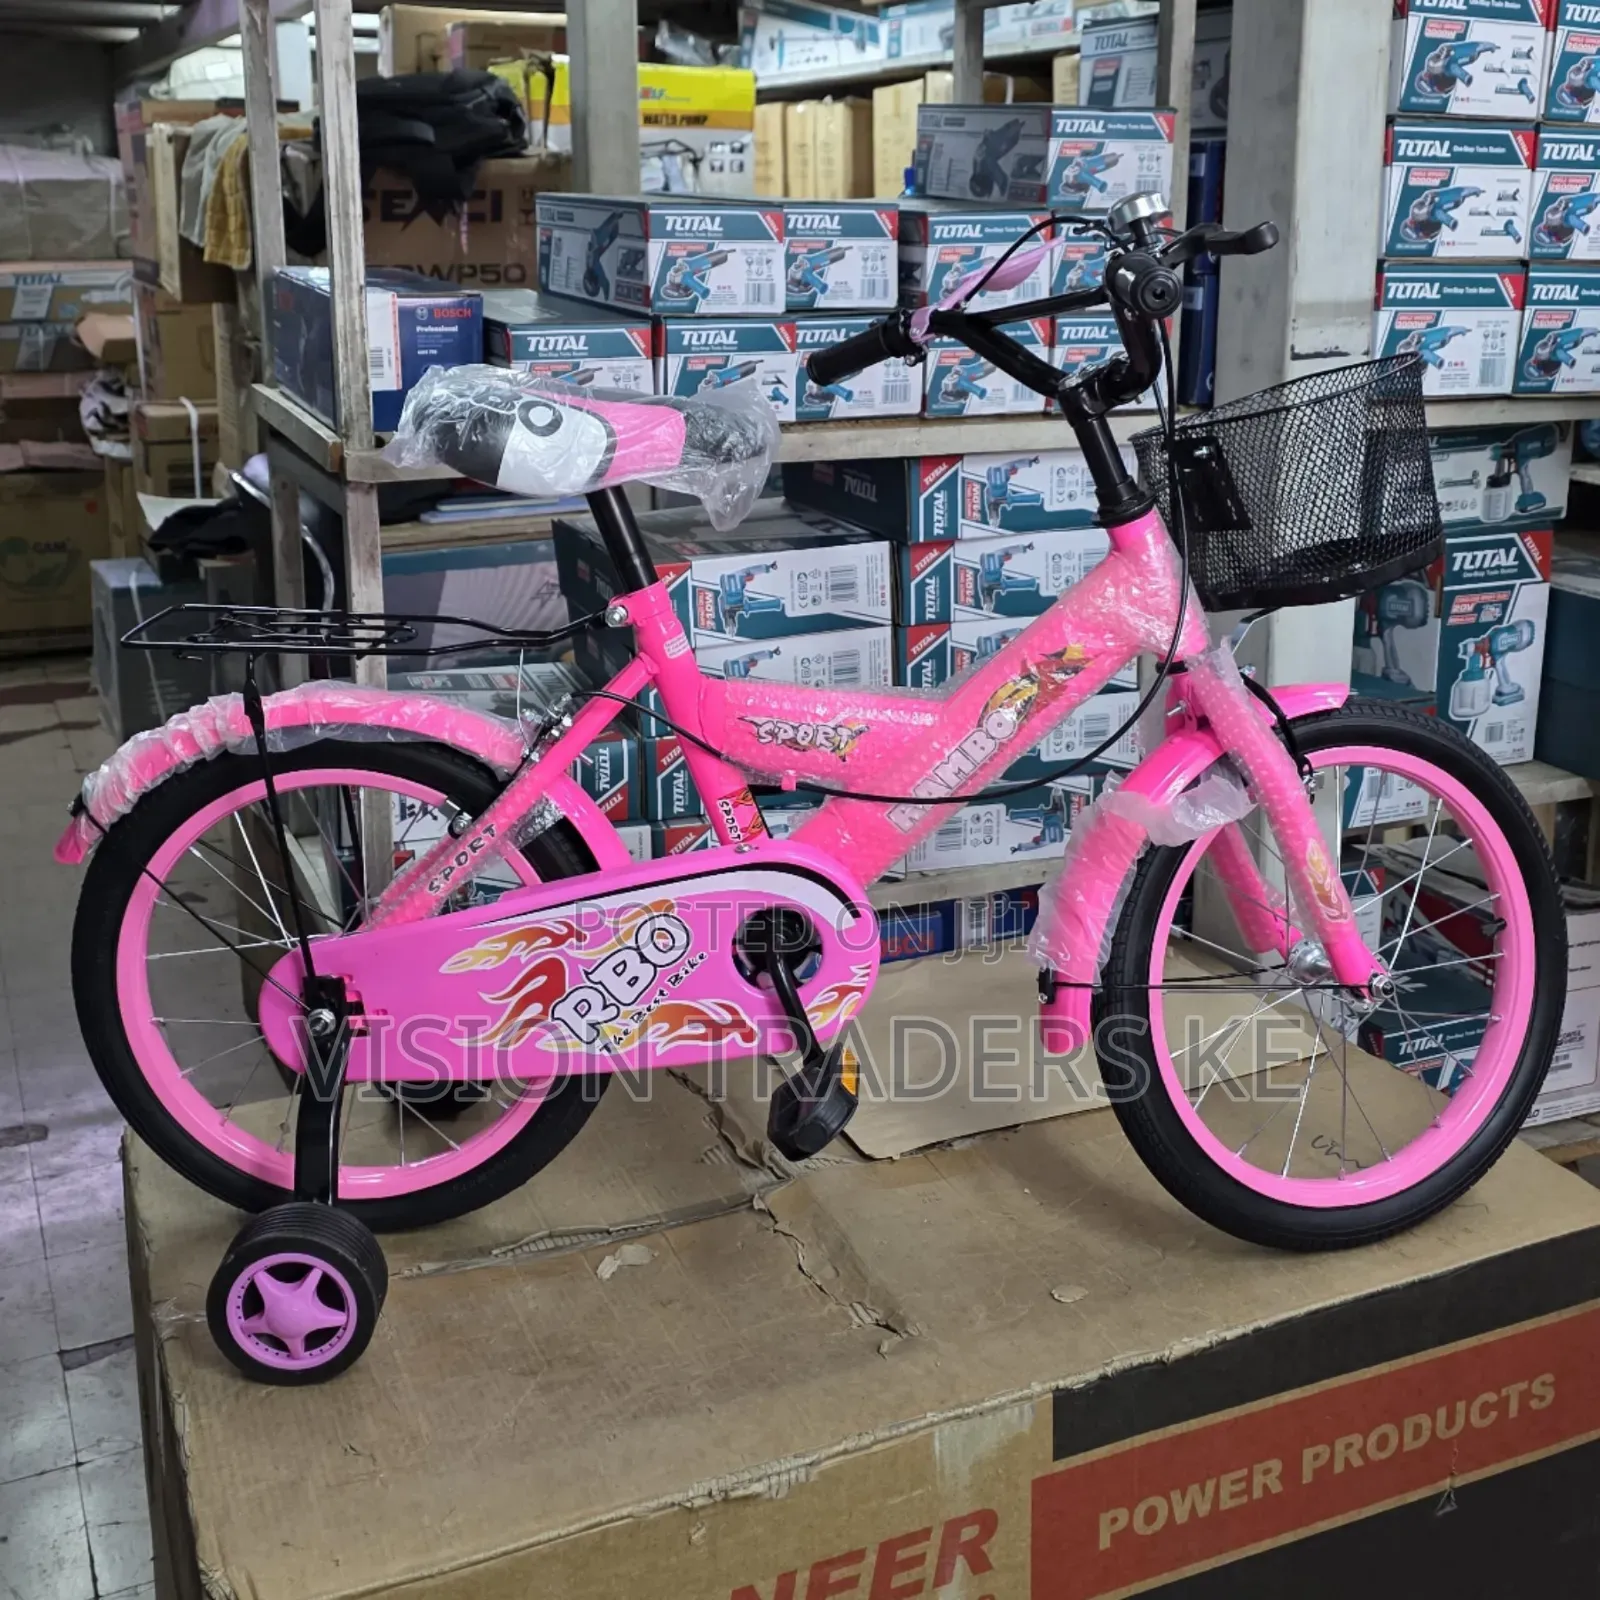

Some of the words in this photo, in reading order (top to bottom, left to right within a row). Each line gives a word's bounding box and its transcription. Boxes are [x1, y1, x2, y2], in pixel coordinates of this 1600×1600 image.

[1056, 118, 1106, 133] TOTAL
[1397, 138, 1452, 157] TOTAL
[1542, 142, 1595, 162] TOTAL
[664, 215, 724, 231] TOTAL
[786, 214, 841, 230] TOTAL
[933, 224, 983, 239] TOTAL
[1386, 282, 1442, 300] TOTAL
[1532, 284, 1580, 301] TOTAL
[433, 308, 472, 319] BOSCH
[416, 325, 459, 333] Professional
[681, 329, 738, 346] TOTAL
[796, 328, 848, 344] TOTAL
[1062, 326, 1109, 340] TOTAL
[527, 335, 589, 352] TOTAL
[922, 461, 949, 486] TOTAL
[932, 490, 945, 537] TOTAL
[914, 548, 940, 572] TOTAL
[1452, 546, 1520, 572] TOTAL
[1524, 534, 1543, 564] TOTAL
[924, 575, 936, 621] TOTAL
[910, 632, 937, 655] TOTAL
[757, 719, 855, 751] SPORT
[597, 746, 611, 792] TOTAL
[672, 769, 685, 815] TOTAL
[718, 799, 742, 842] SPORT
[428, 823, 497, 894] SPORT
[549, 912, 693, 1046] RBO
[598, 1027, 633, 1055] The
[628, 988, 671, 1026] Best
[665, 950, 708, 988] Bike
[1398, 1033, 1445, 1056] TOTAL
[1097, 1457, 1285, 1551] POWER
[1302, 1372, 1557, 1485] PRODUCTS
